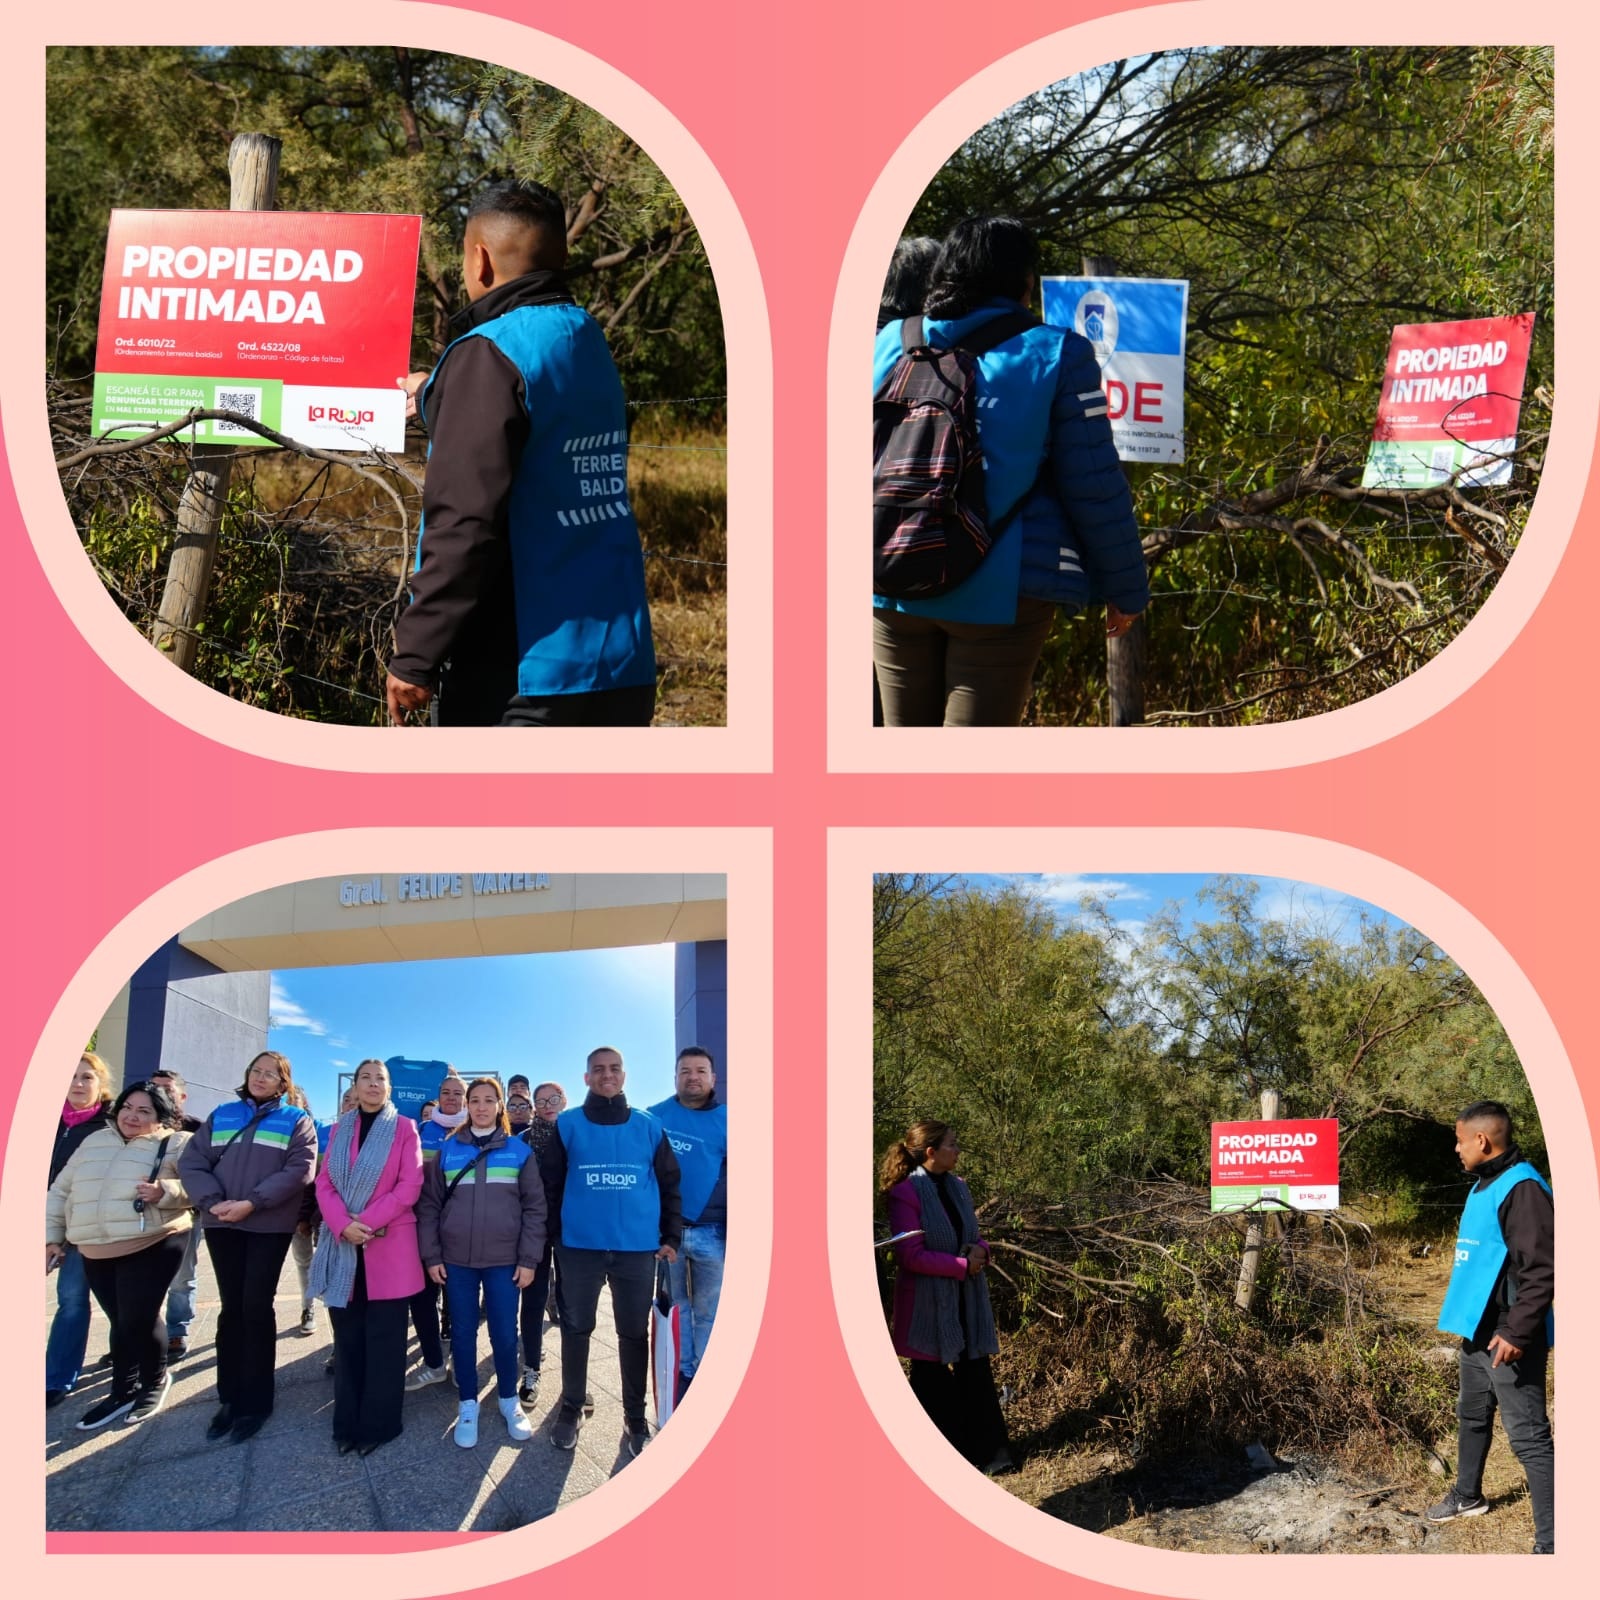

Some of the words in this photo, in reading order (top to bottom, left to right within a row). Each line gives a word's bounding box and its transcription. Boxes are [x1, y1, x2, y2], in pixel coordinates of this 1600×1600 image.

[121, 245, 363, 283] PROPIEDAD
[117, 286, 326, 325] INTIMADA
[115, 337, 135, 347] Ord.
[137, 338, 176, 349] 6010/22
[237, 341, 258, 352] Ord.
[260, 342, 300, 353] 4522/08
[166, 350, 194, 358] terrenos
[284, 352, 310, 364] Código
[310, 354, 320, 363] de
[1395, 341, 1507, 373] PROPIEDAD
[106, 385, 149, 395] ESCANEÁ
[150, 388, 162, 396] EL
[163, 388, 178, 397] QR
[179, 389, 204, 398] PARA
[1390, 374, 1488, 403] INTIMADA
[105, 396, 157, 405] DENUNCIAR
[158, 398, 204, 407] TERRENOS
[116, 406, 132, 414] MAL
[133, 407, 163, 415] ESTADO
[308, 405, 325, 422] La
[572, 453, 626, 474] TERRE
[339, 877, 388, 907] Gral.
[398, 872, 463, 903] FELIPE
[1219, 1133, 1318, 1148] PROPIEDAD
[1219, 1149, 1304, 1165] INTIMADA
[586, 1172, 600, 1186] La
